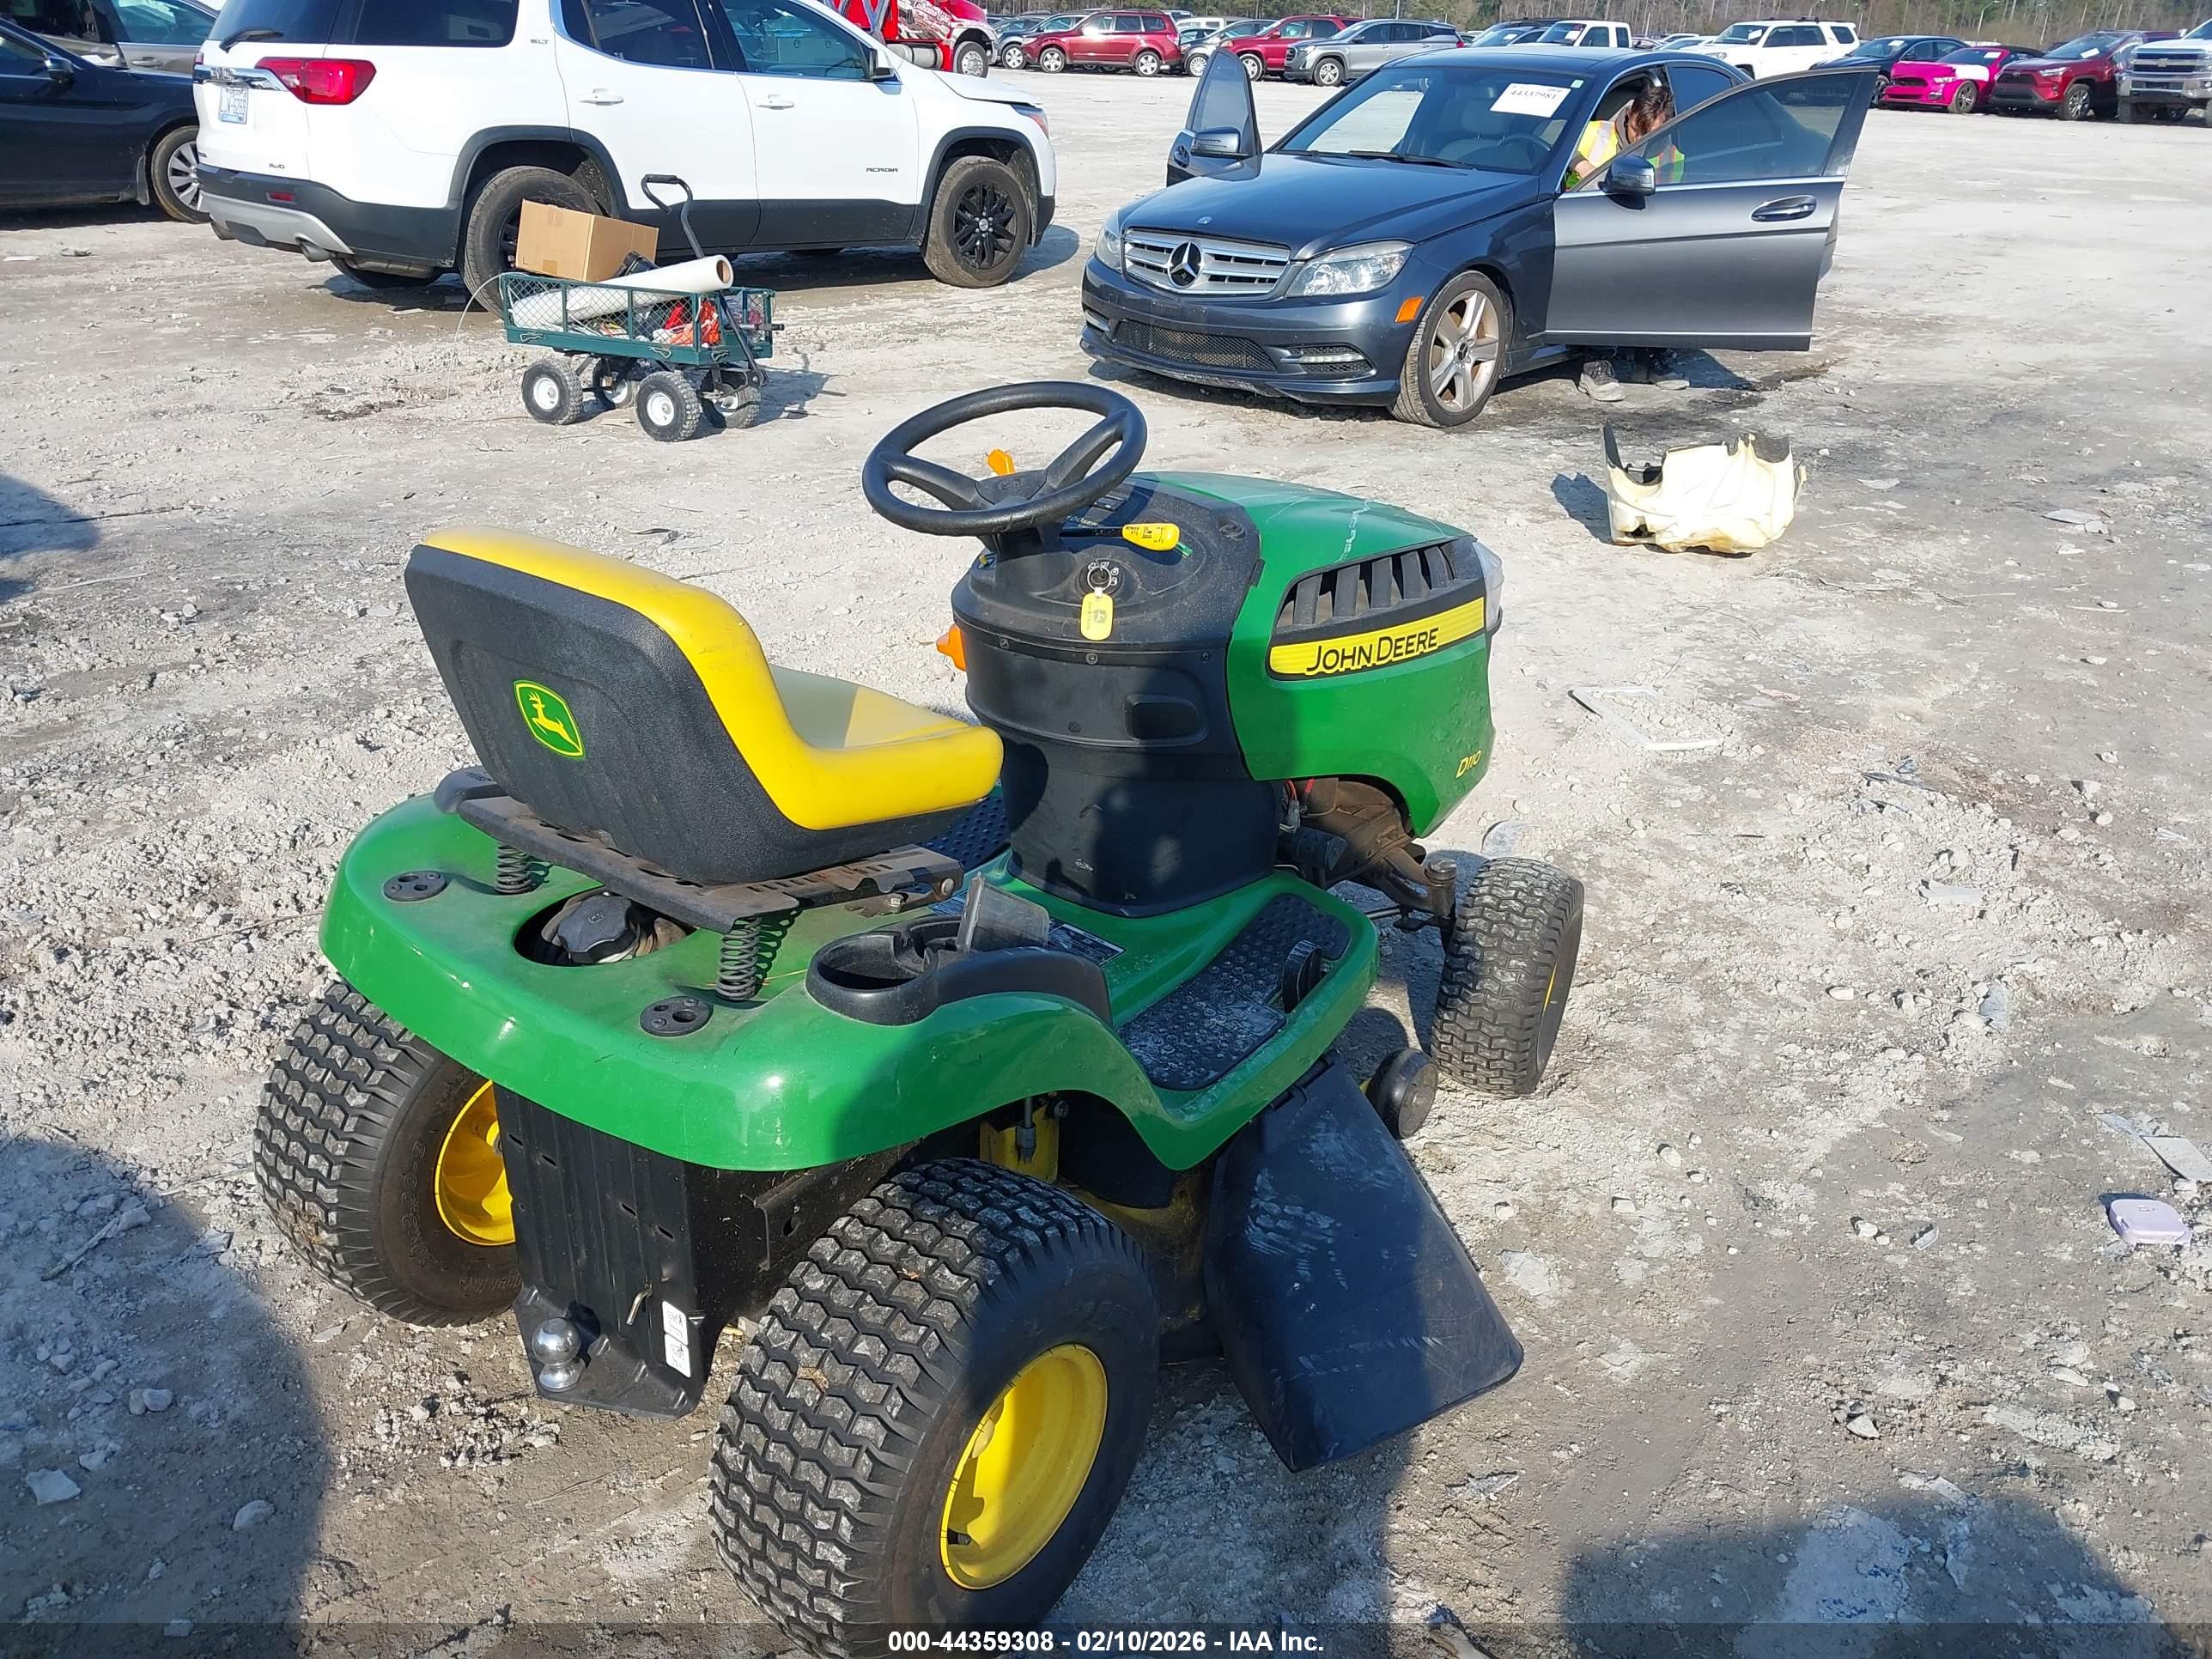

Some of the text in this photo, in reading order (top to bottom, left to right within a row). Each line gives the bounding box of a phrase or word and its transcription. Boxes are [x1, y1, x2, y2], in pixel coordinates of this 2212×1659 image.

[1307, 627, 1439, 672] JOHN DEERE
[1456, 749, 1483, 779] D110
